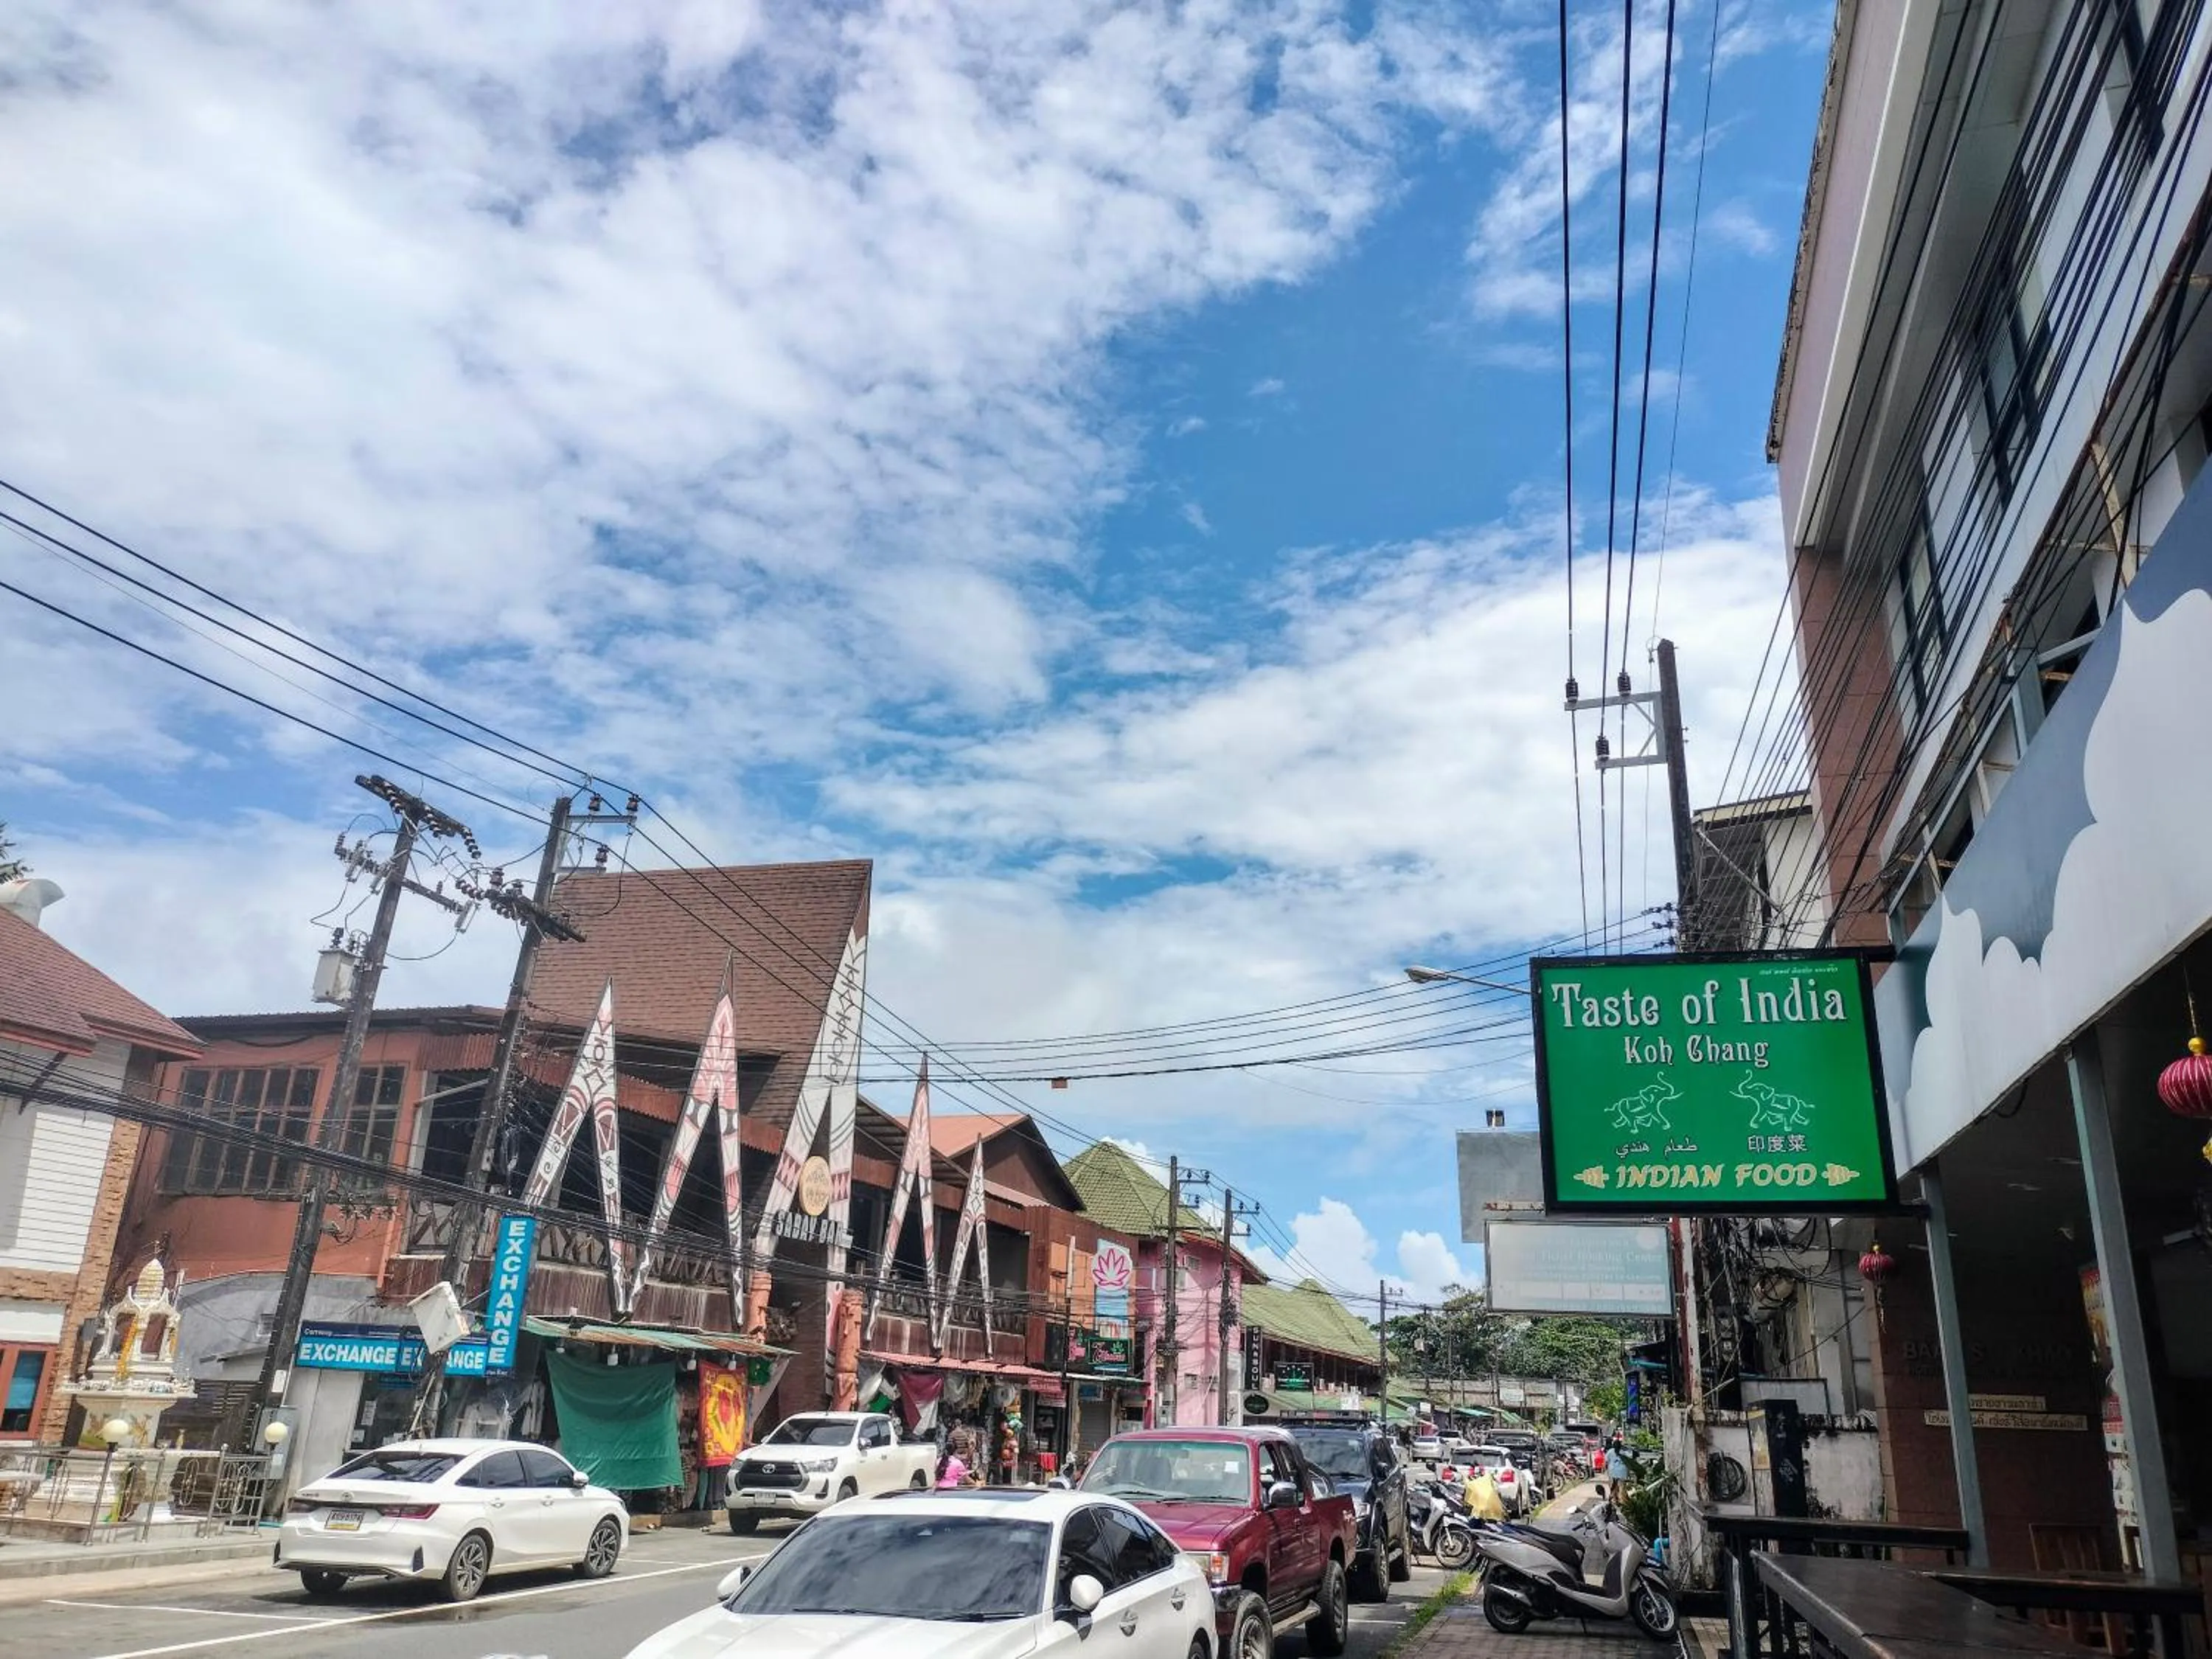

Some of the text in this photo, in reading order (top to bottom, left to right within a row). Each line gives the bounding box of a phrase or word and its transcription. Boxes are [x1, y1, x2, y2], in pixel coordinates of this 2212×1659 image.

[1551, 977, 1847, 1027] Taste of India
[1624, 1034, 1769, 1068] Koh Chang
[1616, 1136, 1697, 1158] طعام هندي
[1748, 1135, 1806, 1153] 印度菜
[1615, 1163, 1817, 1189] INDIAN FOOD
[776, 1210, 818, 1242] SABAY
[488, 1220, 527, 1363] EXCHANGE
[299, 1342, 486, 1370] EXCHANGE EXANGE
